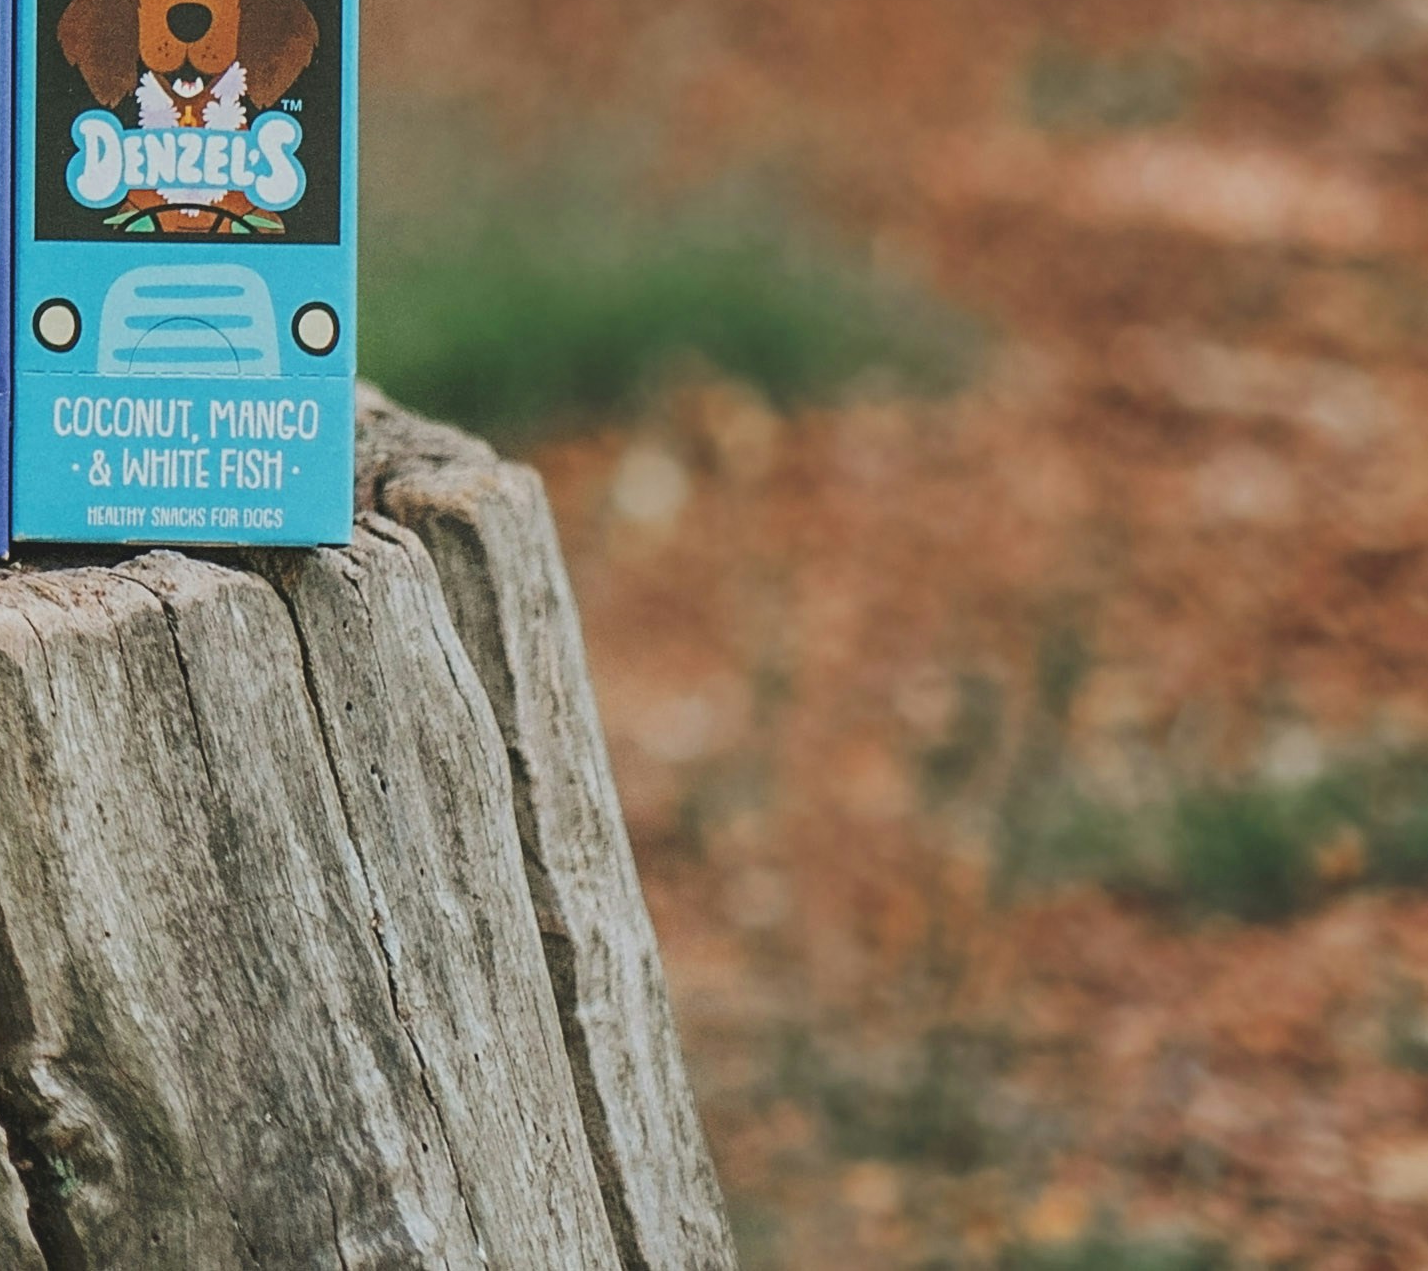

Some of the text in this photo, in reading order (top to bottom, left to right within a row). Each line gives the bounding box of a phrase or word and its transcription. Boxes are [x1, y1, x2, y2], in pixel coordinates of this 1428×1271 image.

[281, 99, 303, 112] TM
[76, 118, 299, 204] DENZEL'S
[53, 396, 319, 444] COCONUT, MANGO
[88, 447, 283, 490] & WHITE FISH
[87, 506, 284, 528] HEALTHY SNACKS FOR DOGS
